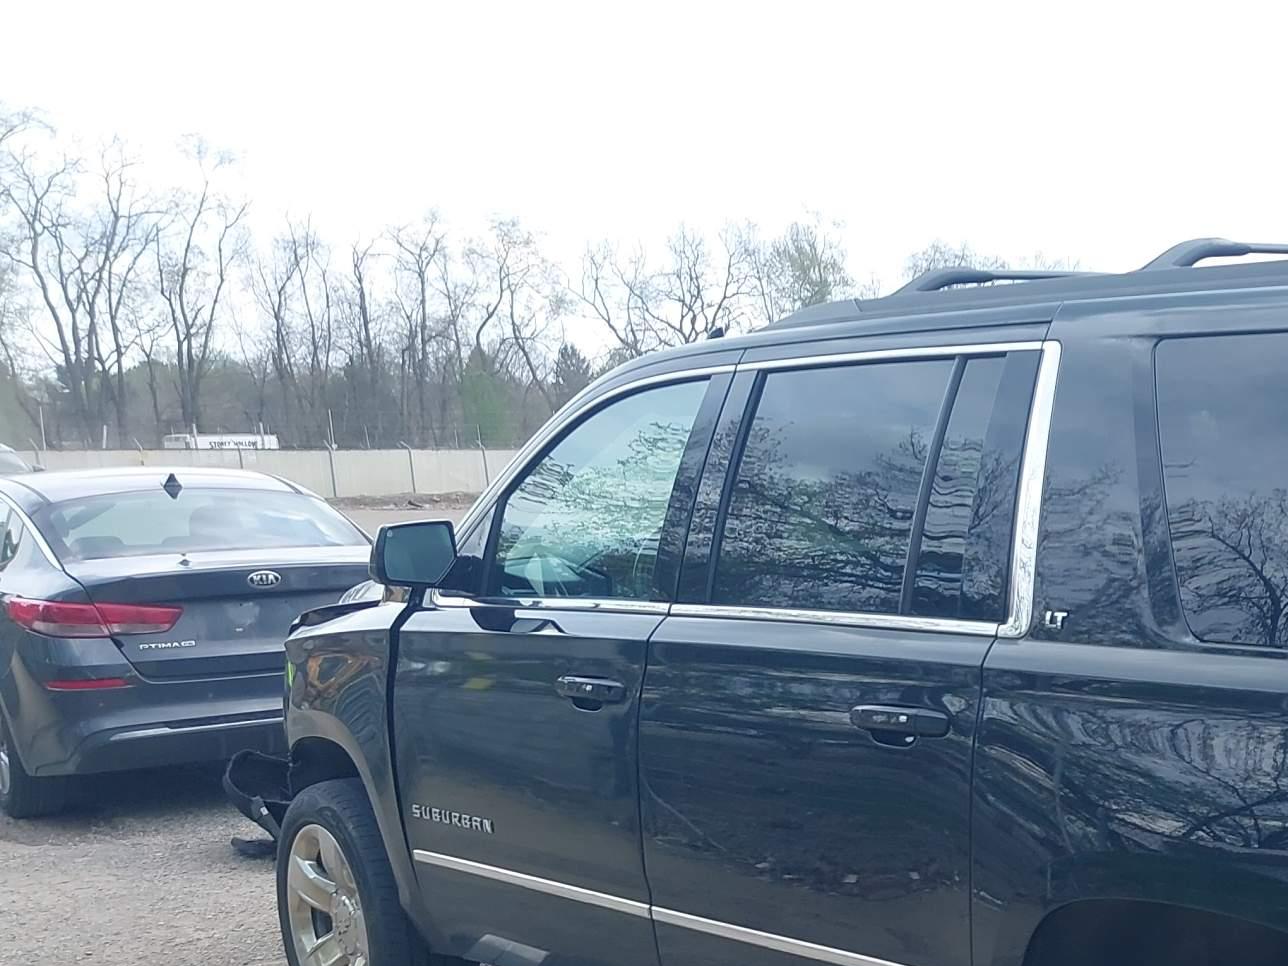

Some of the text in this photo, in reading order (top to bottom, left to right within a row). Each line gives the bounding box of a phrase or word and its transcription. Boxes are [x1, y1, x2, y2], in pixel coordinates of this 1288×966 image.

[251, 573, 278, 586] KIA
[1045, 610, 1068, 630] LT
[411, 803, 494, 834] SUBURBAN
